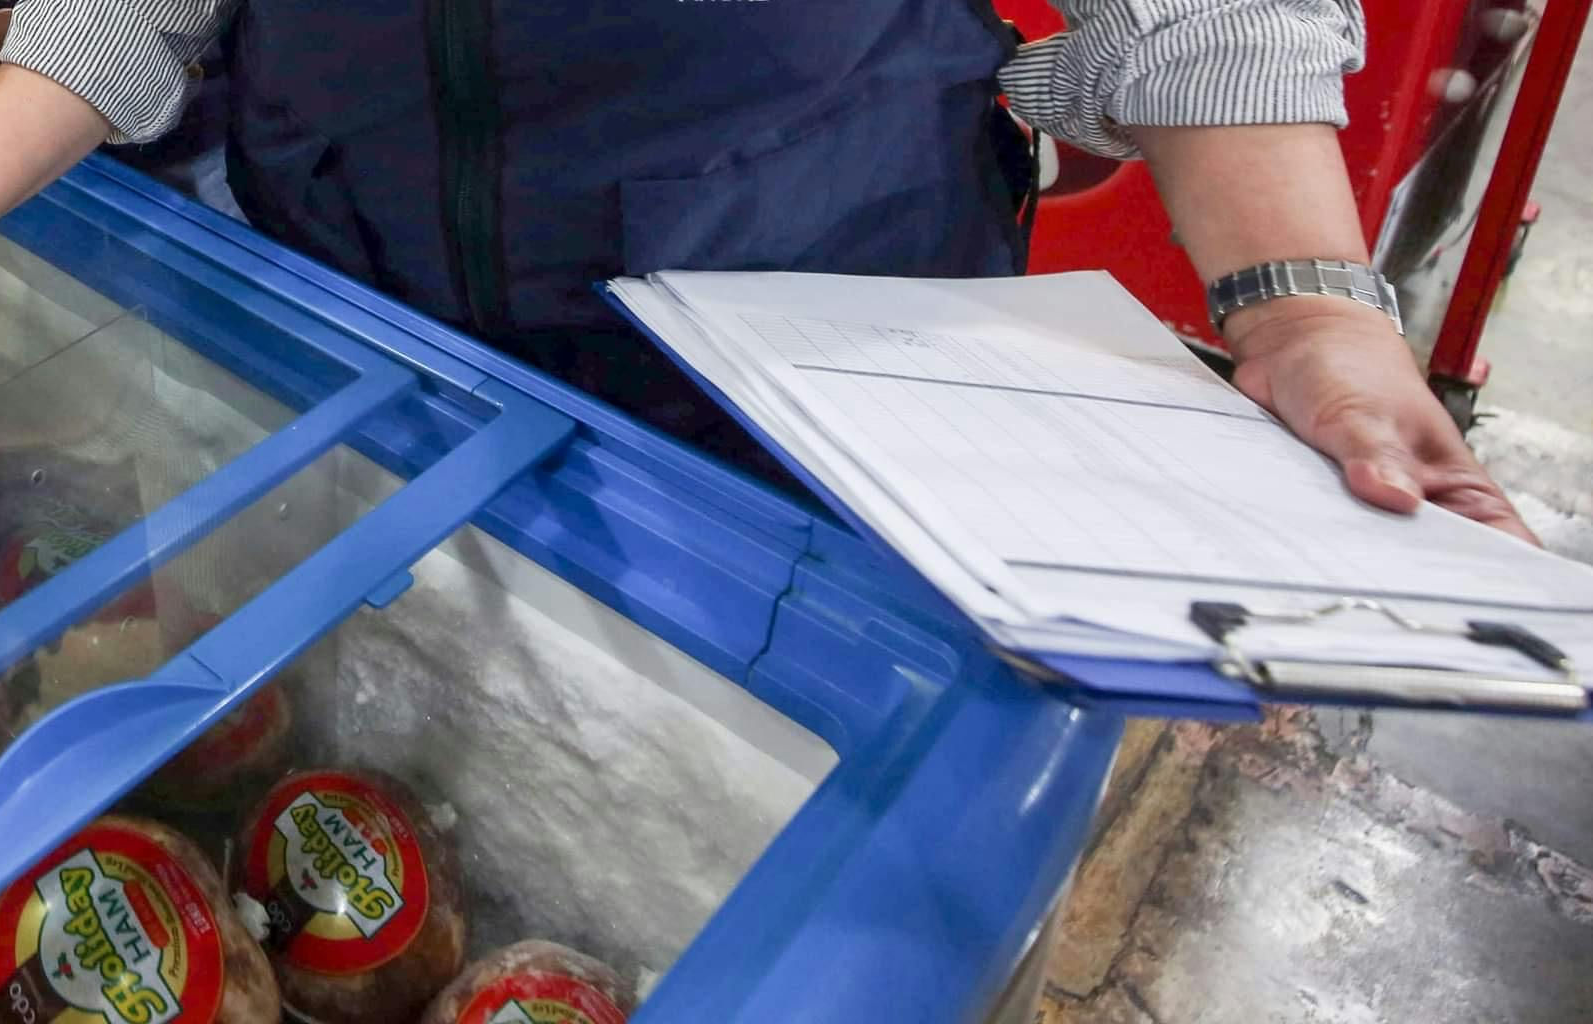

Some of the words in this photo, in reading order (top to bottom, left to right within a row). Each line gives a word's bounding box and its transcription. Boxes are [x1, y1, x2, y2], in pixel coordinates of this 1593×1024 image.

[291, 803, 395, 920] Holiday
[324, 814, 376, 871] HAM
[59, 867, 168, 1024] Holiday
[98, 887, 153, 964] HAM
